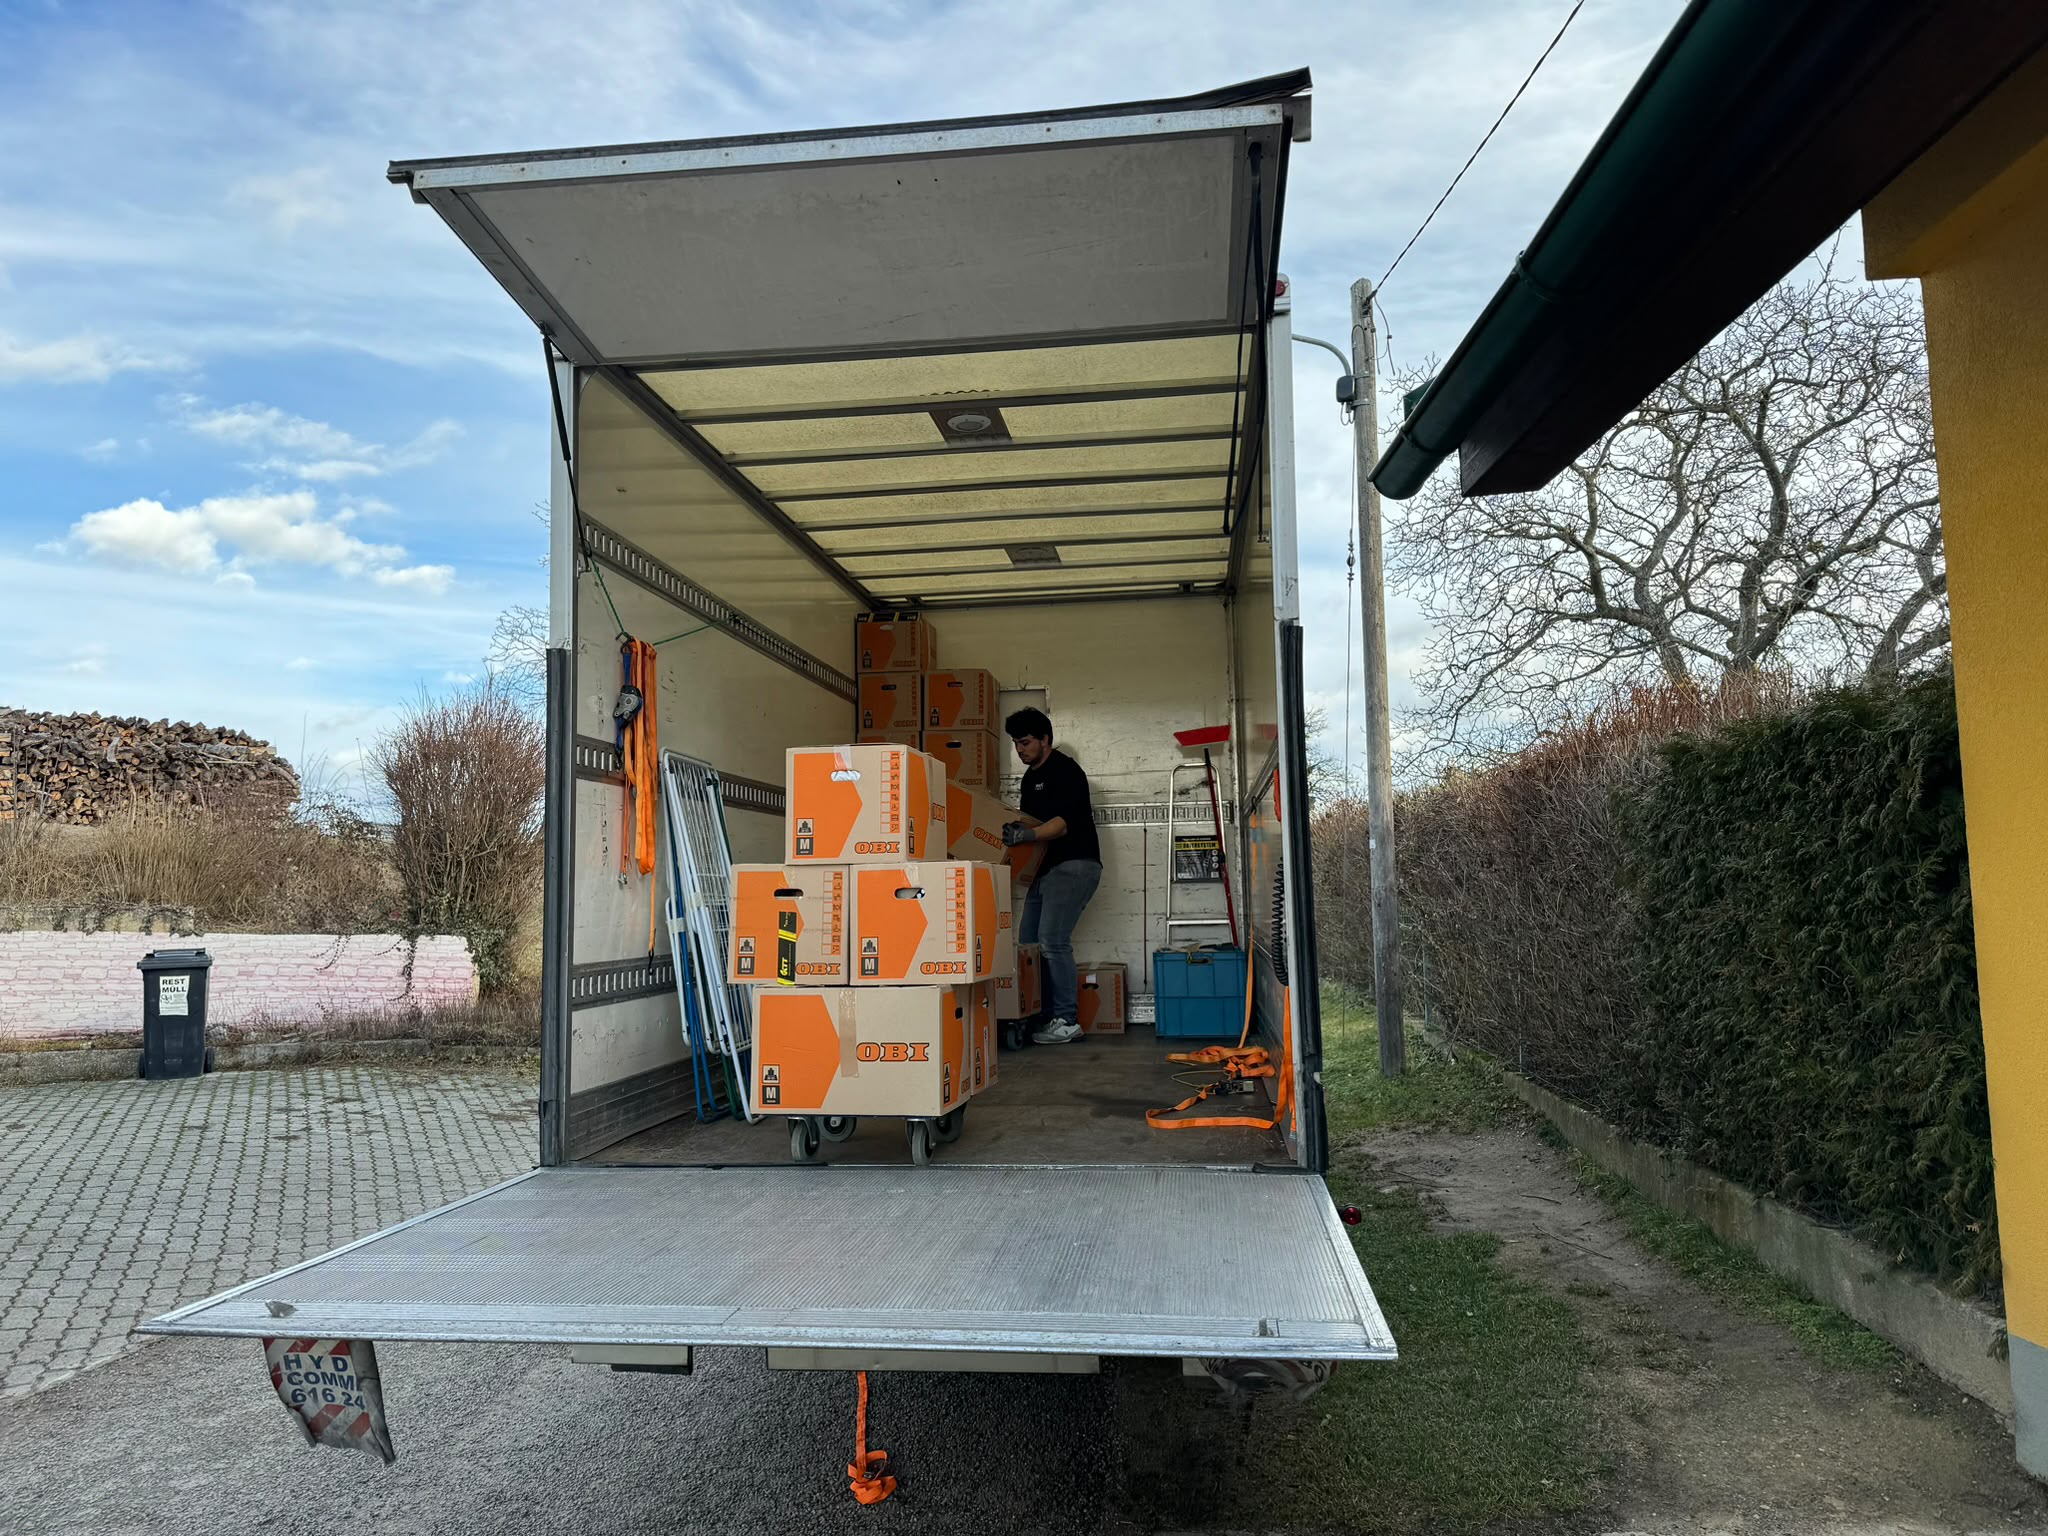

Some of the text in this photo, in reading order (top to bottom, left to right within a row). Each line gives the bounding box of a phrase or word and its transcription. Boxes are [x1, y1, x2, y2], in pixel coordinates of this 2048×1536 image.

[800, 839, 810, 850] M
[855, 841, 901, 855] OBI
[741, 957, 751, 969] M
[795, 962, 841, 976] OBI
[864, 958, 875, 970] M
[920, 961, 966, 975] OBI
[856, 1042, 929, 1062] OBI
[766, 1086, 776, 1099] M
